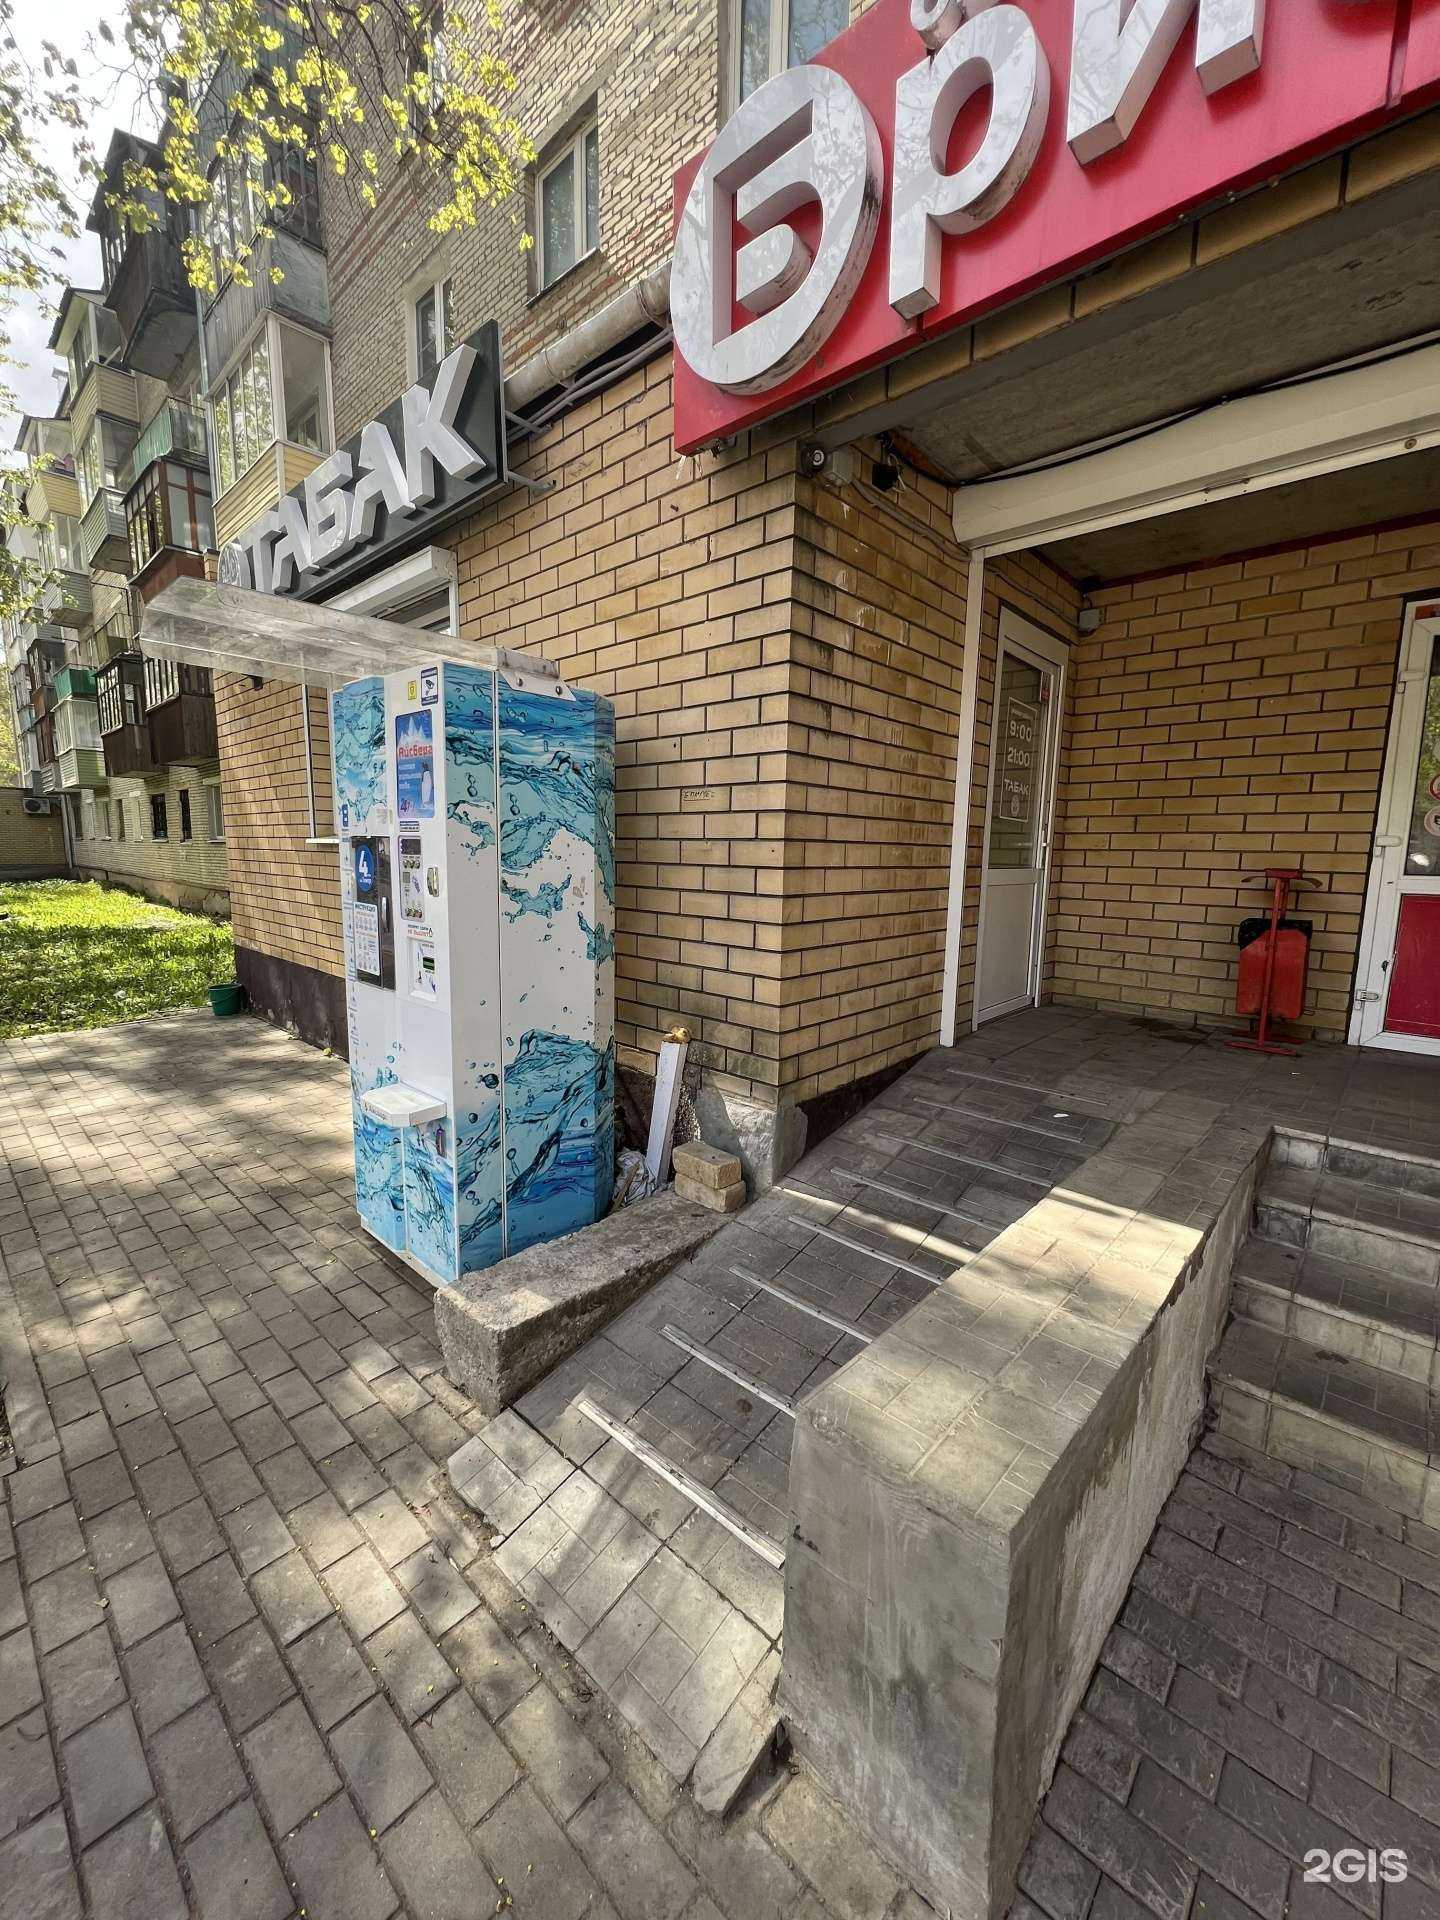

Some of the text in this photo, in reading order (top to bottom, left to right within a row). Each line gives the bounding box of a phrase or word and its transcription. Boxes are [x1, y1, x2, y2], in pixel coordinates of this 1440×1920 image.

[237, 344, 487, 594] ТАБАК
[1004, 779, 1029, 796] ТАБАК
[359, 850, 369, 878] 4
